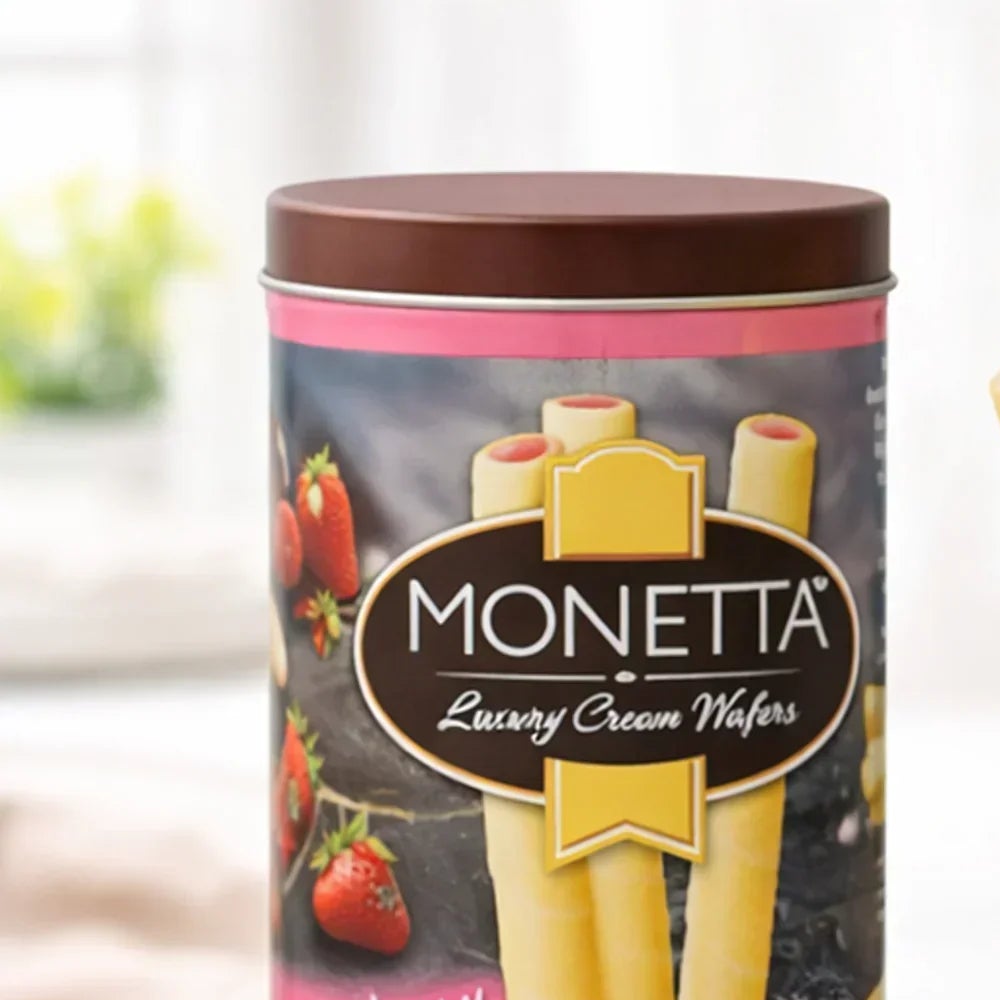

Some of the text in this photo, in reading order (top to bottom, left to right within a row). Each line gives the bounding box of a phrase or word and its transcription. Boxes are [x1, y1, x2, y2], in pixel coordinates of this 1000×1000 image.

[409, 578, 829, 658] MONETTA
[436, 687, 800, 746] Luxury Cream Wafers
